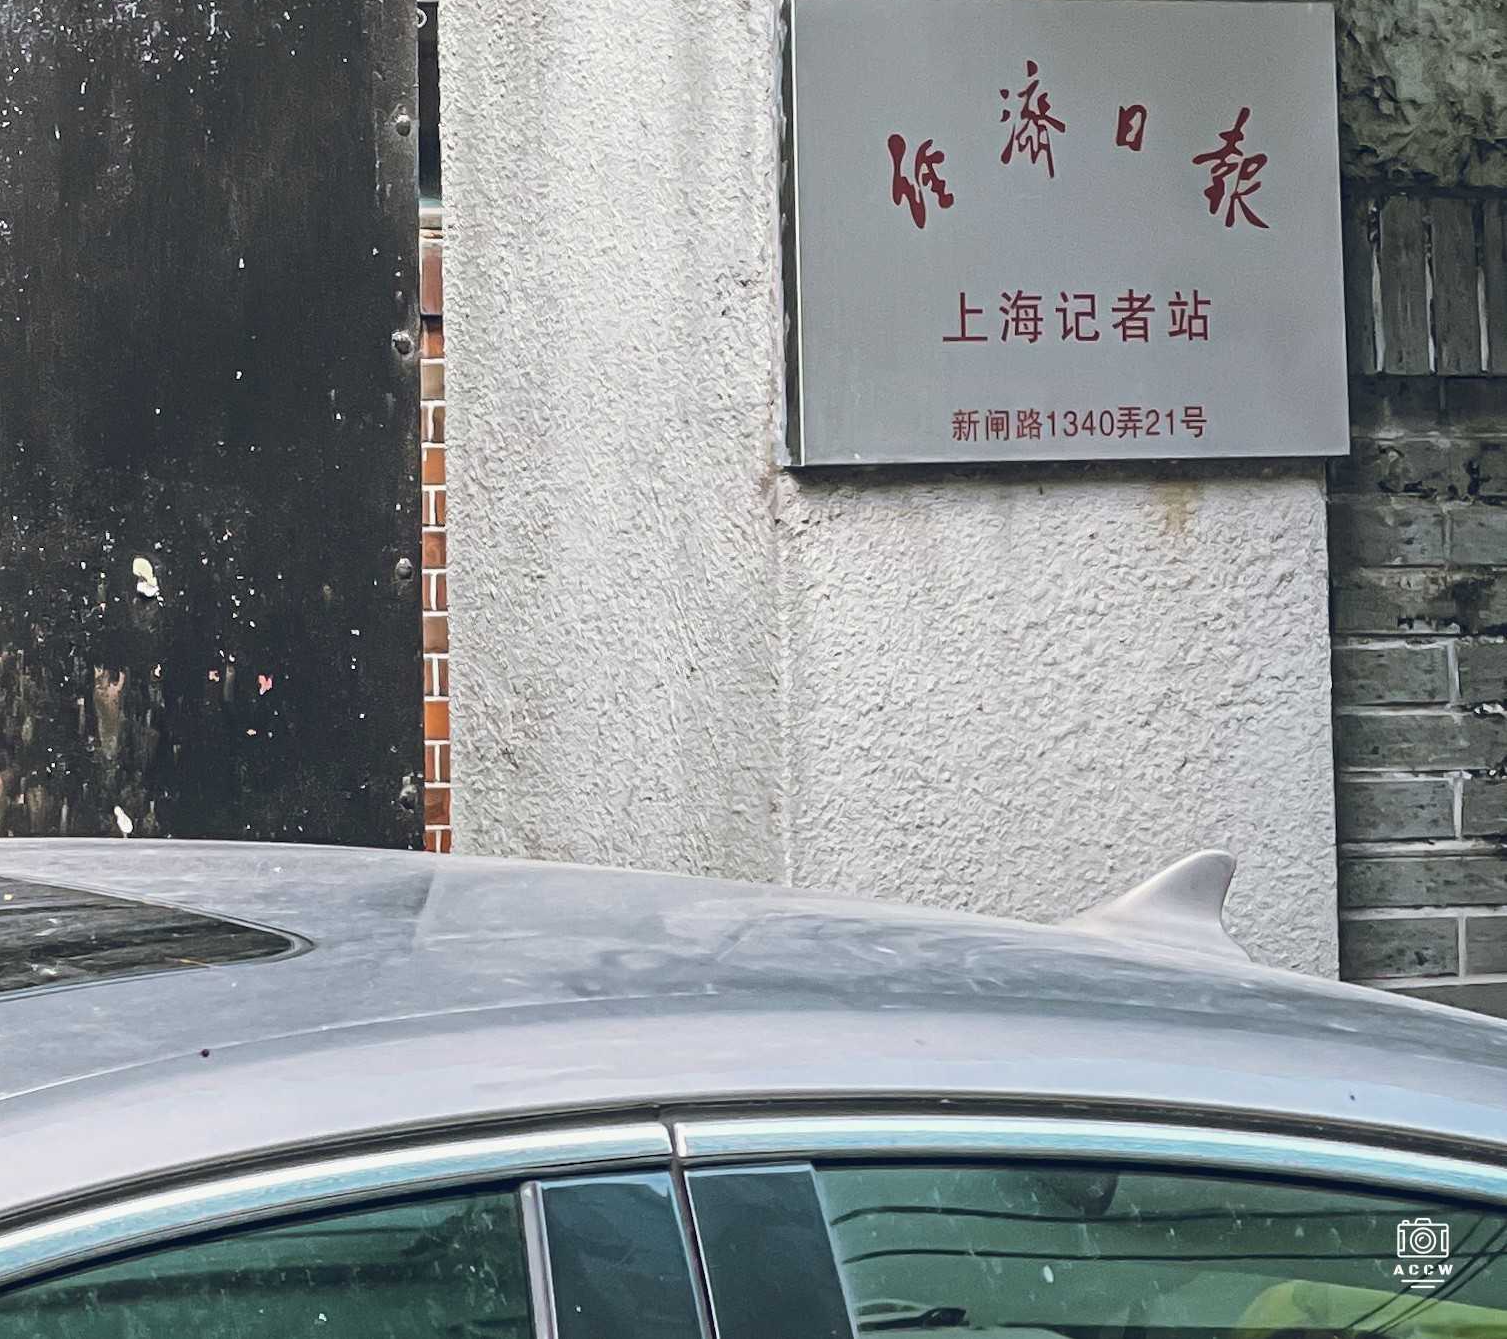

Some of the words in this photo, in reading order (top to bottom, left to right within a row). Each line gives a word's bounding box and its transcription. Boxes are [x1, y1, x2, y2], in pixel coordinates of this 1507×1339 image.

[942, 289, 1212, 343] 上海记者站
[951, 405, 1208, 442] 新闸路1340弄21号
